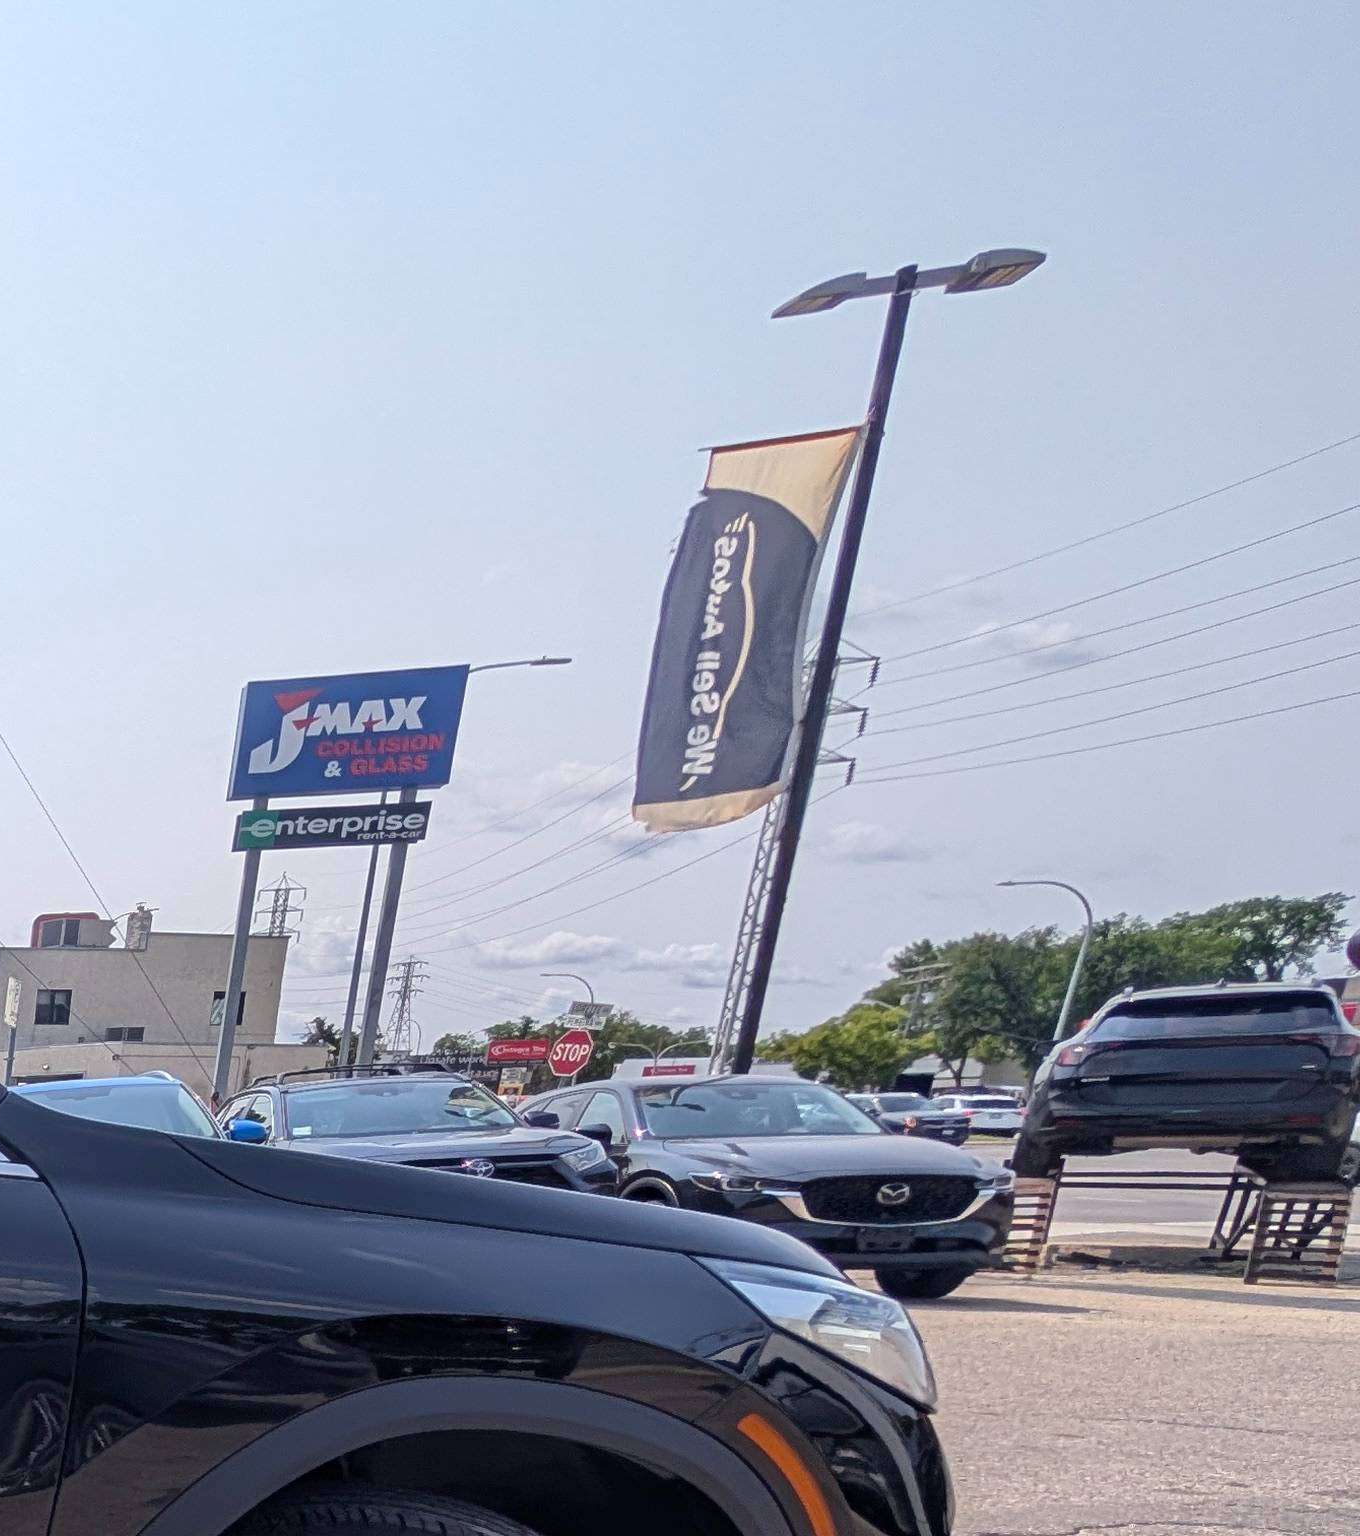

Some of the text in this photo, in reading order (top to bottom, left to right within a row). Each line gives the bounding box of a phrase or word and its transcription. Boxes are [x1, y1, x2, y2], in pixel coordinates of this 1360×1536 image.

[316, 735, 445, 759] COLLISION
[324, 754, 429, 777] & GLASS
[248, 810, 425, 839] enterprise
[357, 829, 423, 841] rent-a-car
[553, 1043, 589, 1062] STOP
